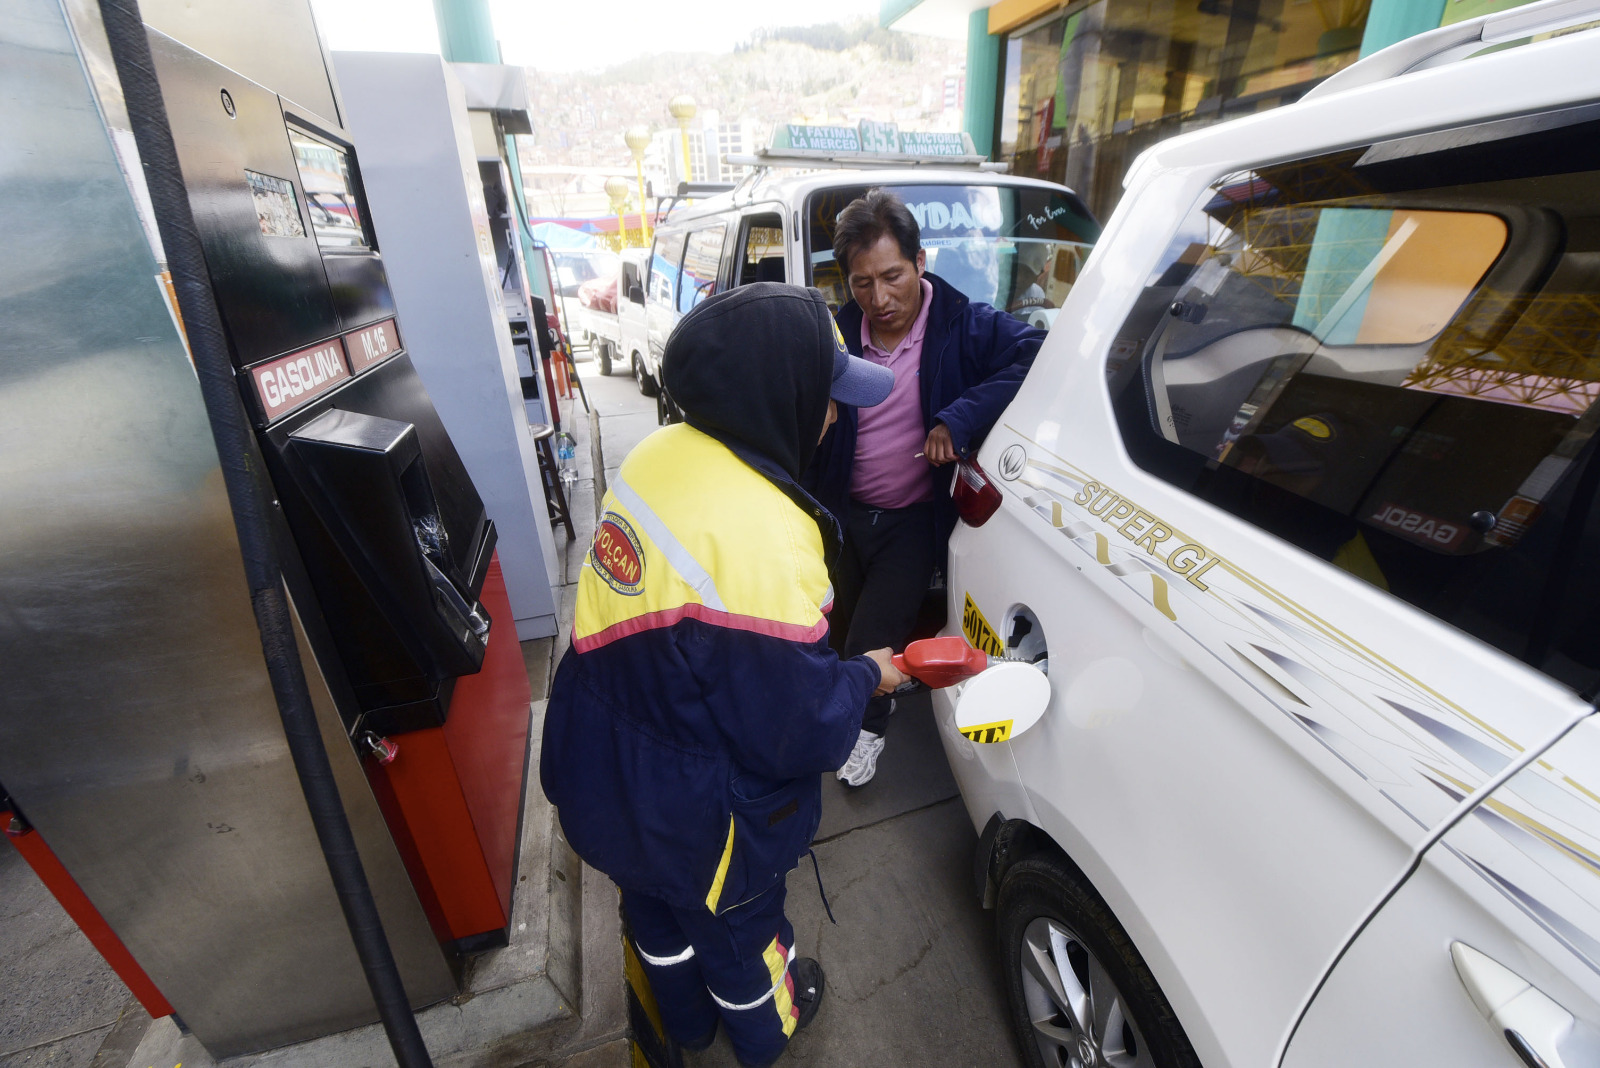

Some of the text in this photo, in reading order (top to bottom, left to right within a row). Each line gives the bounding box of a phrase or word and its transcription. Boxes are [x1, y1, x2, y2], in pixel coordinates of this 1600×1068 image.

[790, 126, 855, 139] V. FATIMA
[792, 138, 857, 149] LA MERCED
[862, 120, 898, 151] 353
[902, 133, 961, 144] V. VICTORIA
[904, 145, 963, 155] MUNAYPATA
[260, 326, 388, 408] GASOLINA M.16
[1074, 481, 1220, 591] SUPER GL
[597, 525, 637, 580] VOLCAN
